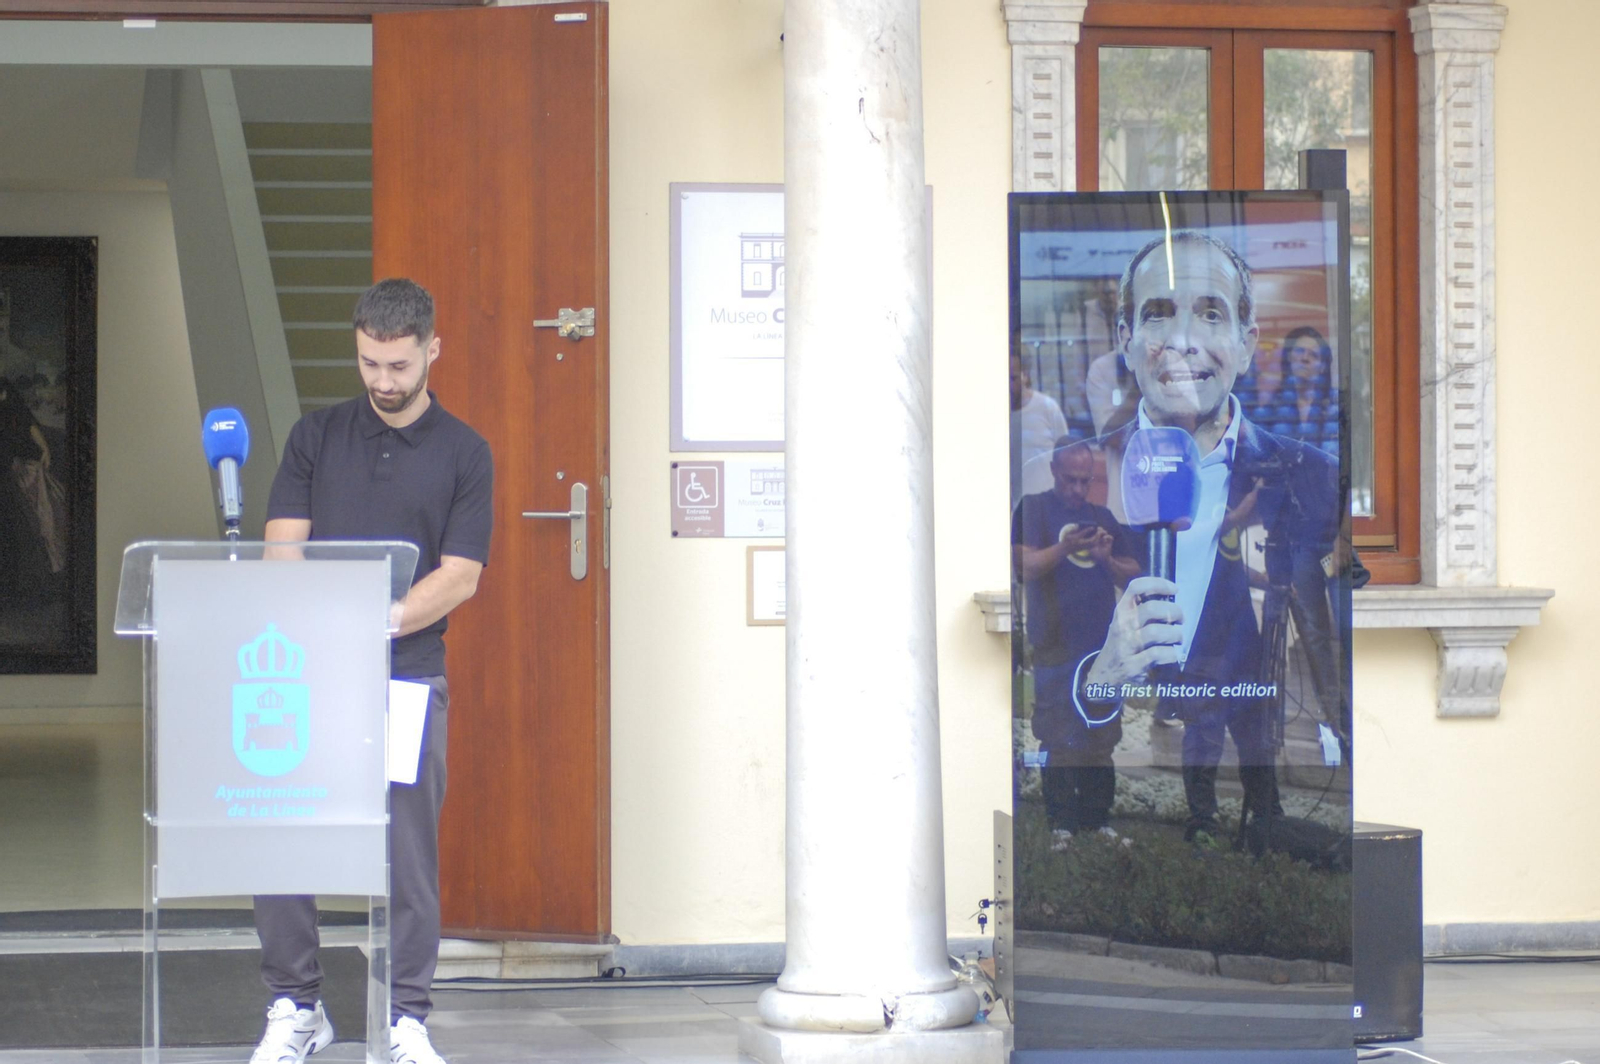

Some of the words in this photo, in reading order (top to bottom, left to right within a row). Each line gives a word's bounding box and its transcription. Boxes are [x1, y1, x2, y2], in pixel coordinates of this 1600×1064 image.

[710, 307, 767, 324] Museo
[763, 498, 782, 506] Cruz
[1086, 683, 1115, 698] this
[1120, 683, 1151, 698] first
[1156, 683, 1216, 698] historic
[1220, 683, 1277, 698] edition
[215, 784, 328, 802] Ayuntamiento
[227, 803, 247, 818] de
[250, 803, 269, 818] La
